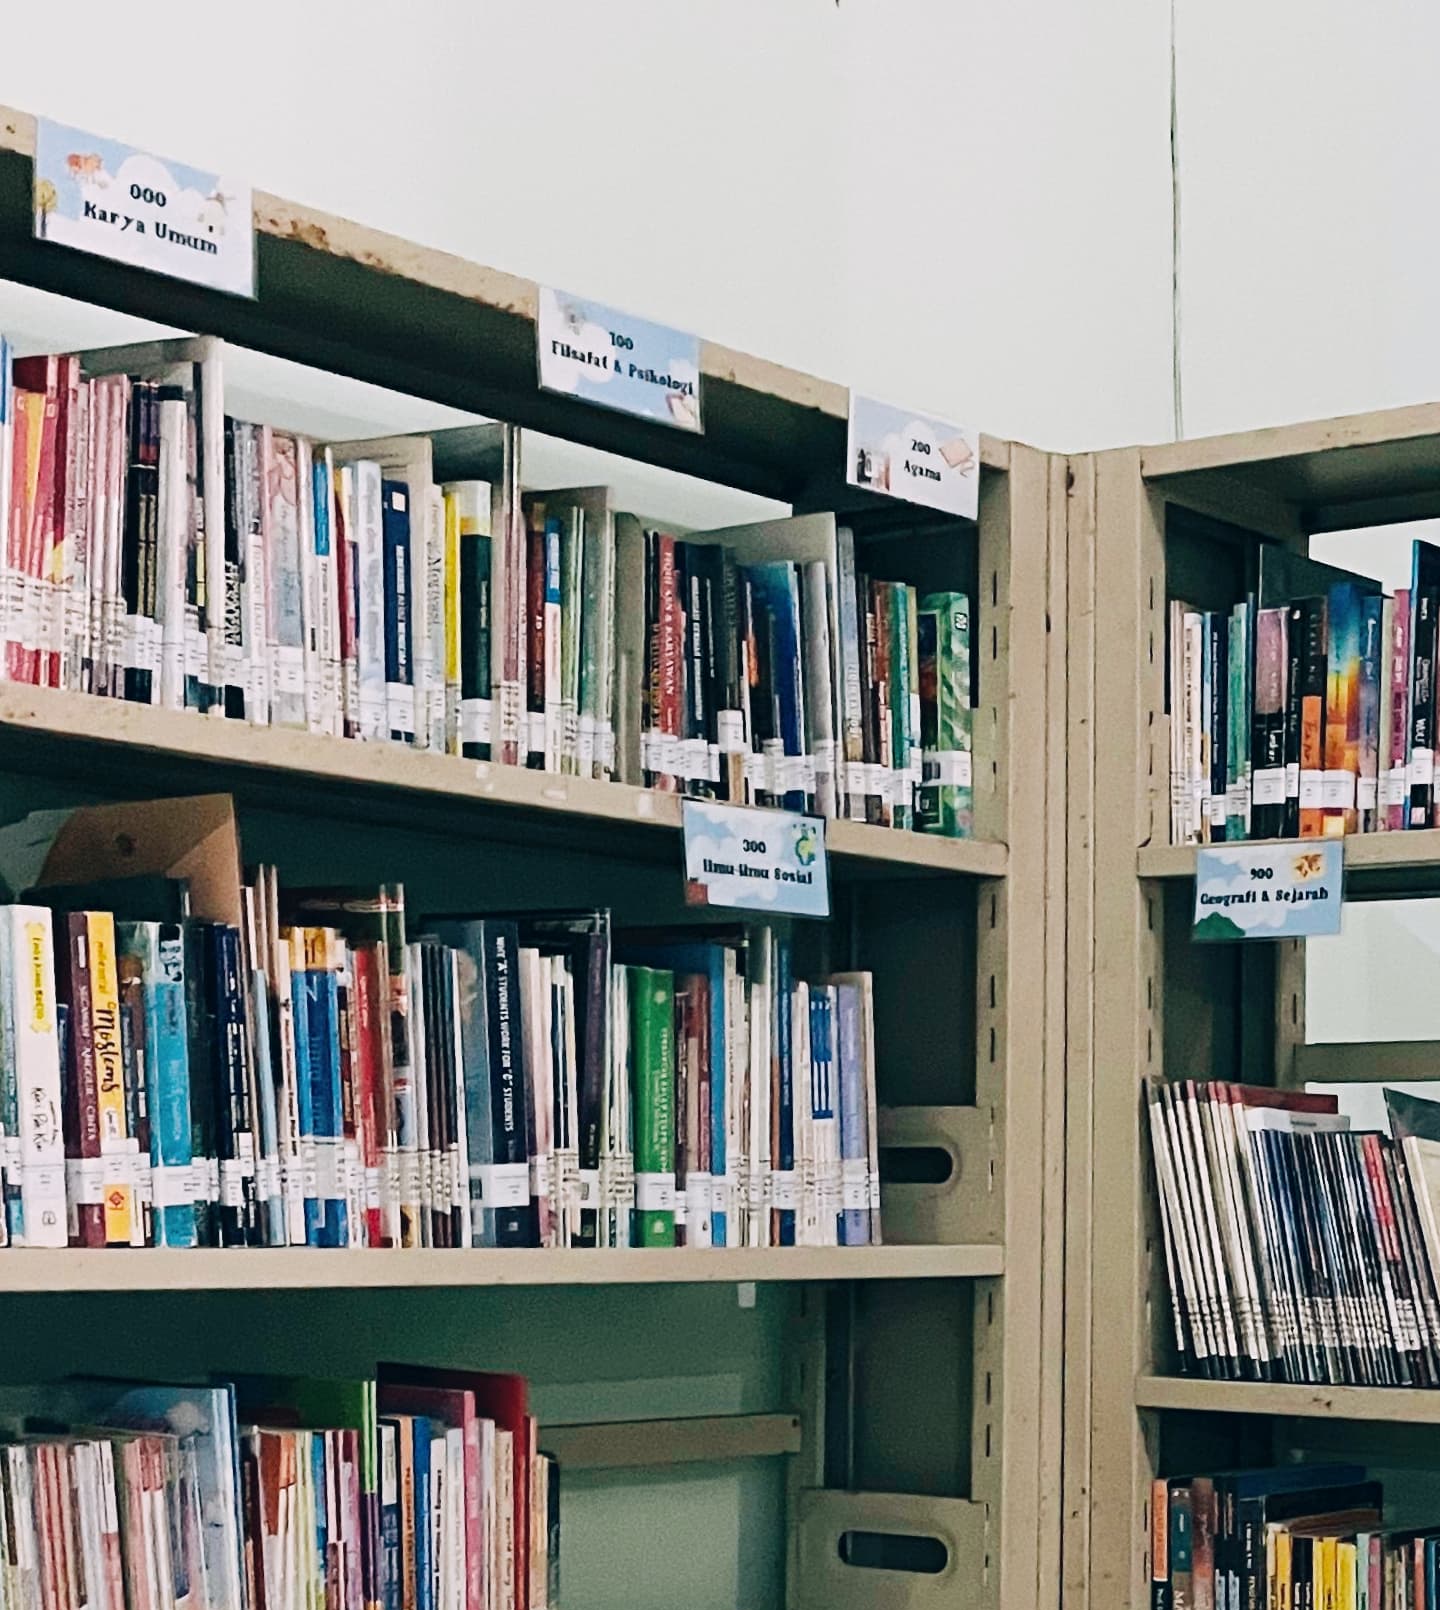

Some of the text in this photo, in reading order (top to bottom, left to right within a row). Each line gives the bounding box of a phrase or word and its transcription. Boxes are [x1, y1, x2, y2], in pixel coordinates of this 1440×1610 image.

[130, 183, 167, 208] 000
[84, 201, 218, 255] Karya Umum
[608, 331, 634, 350] 100
[551, 340, 608, 369] Filsafat
[628, 363, 693, 396] Psikologi
[911, 439, 931, 455] 200
[904, 459, 941, 482] Agama
[742, 839, 766, 854] 300
[774, 867, 813, 885] Sosial
[1250, 867, 1274, 880] 900
[1200, 890, 1257, 907] Geografi
[1275, 886, 1329, 904] Sejarah
[499, 977, 510, 1021] STUDENTS
[500, 1022, 512, 1049] WORK
[501, 1051, 512, 1069] FOR
[504, 1088, 514, 1133] STUDENTS
